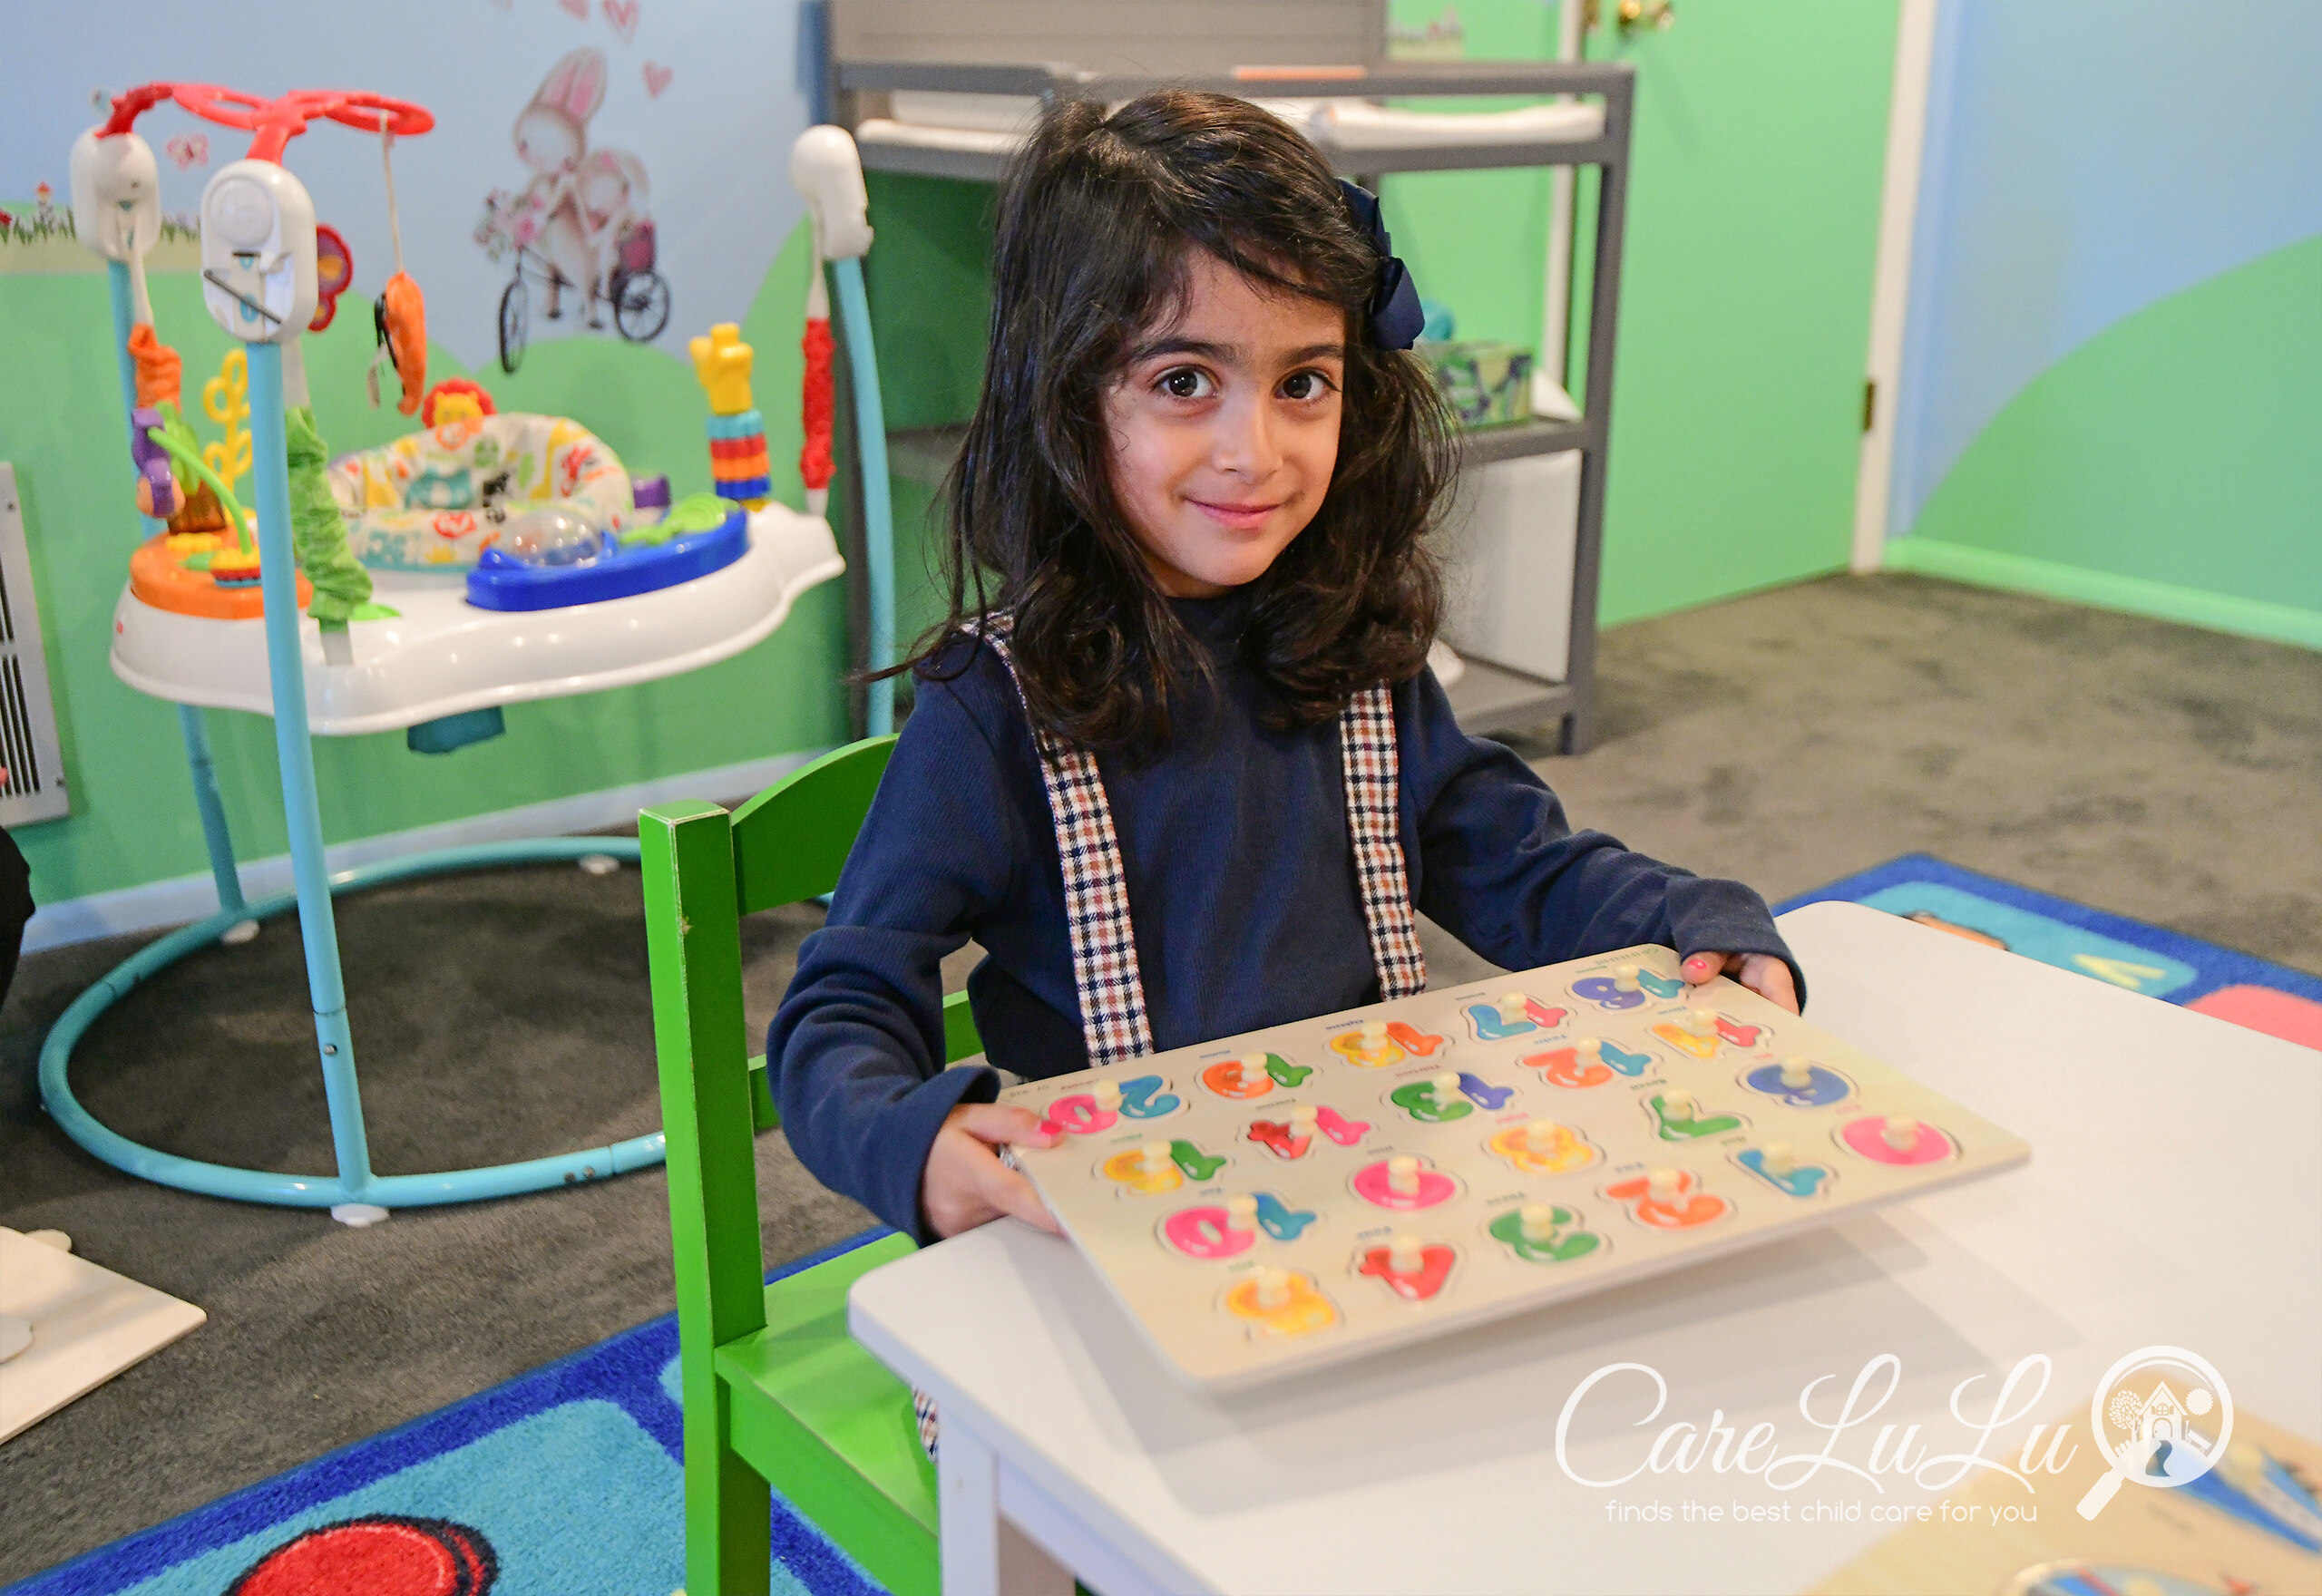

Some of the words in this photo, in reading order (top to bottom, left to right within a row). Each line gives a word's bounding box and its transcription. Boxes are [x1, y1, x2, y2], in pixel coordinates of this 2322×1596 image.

[1571, 968, 1685, 1010] 16
[1328, 1020, 1445, 1066] 18
[1468, 998, 1567, 1041] 17
[1651, 1008, 1761, 1057] 11
[1521, 1037, 1652, 1089] 12
[1746, 1060, 1850, 1105] 6
[1049, 1075, 1180, 1134] 20
[1390, 1071, 1515, 1122] 13
[1647, 1094, 1742, 1142] 7
[1102, 1138, 1227, 1192] 15
[1605, 1170, 1726, 1229] 2
[1164, 1192, 1316, 1259] 10
[1488, 1202, 1601, 1263] 3
